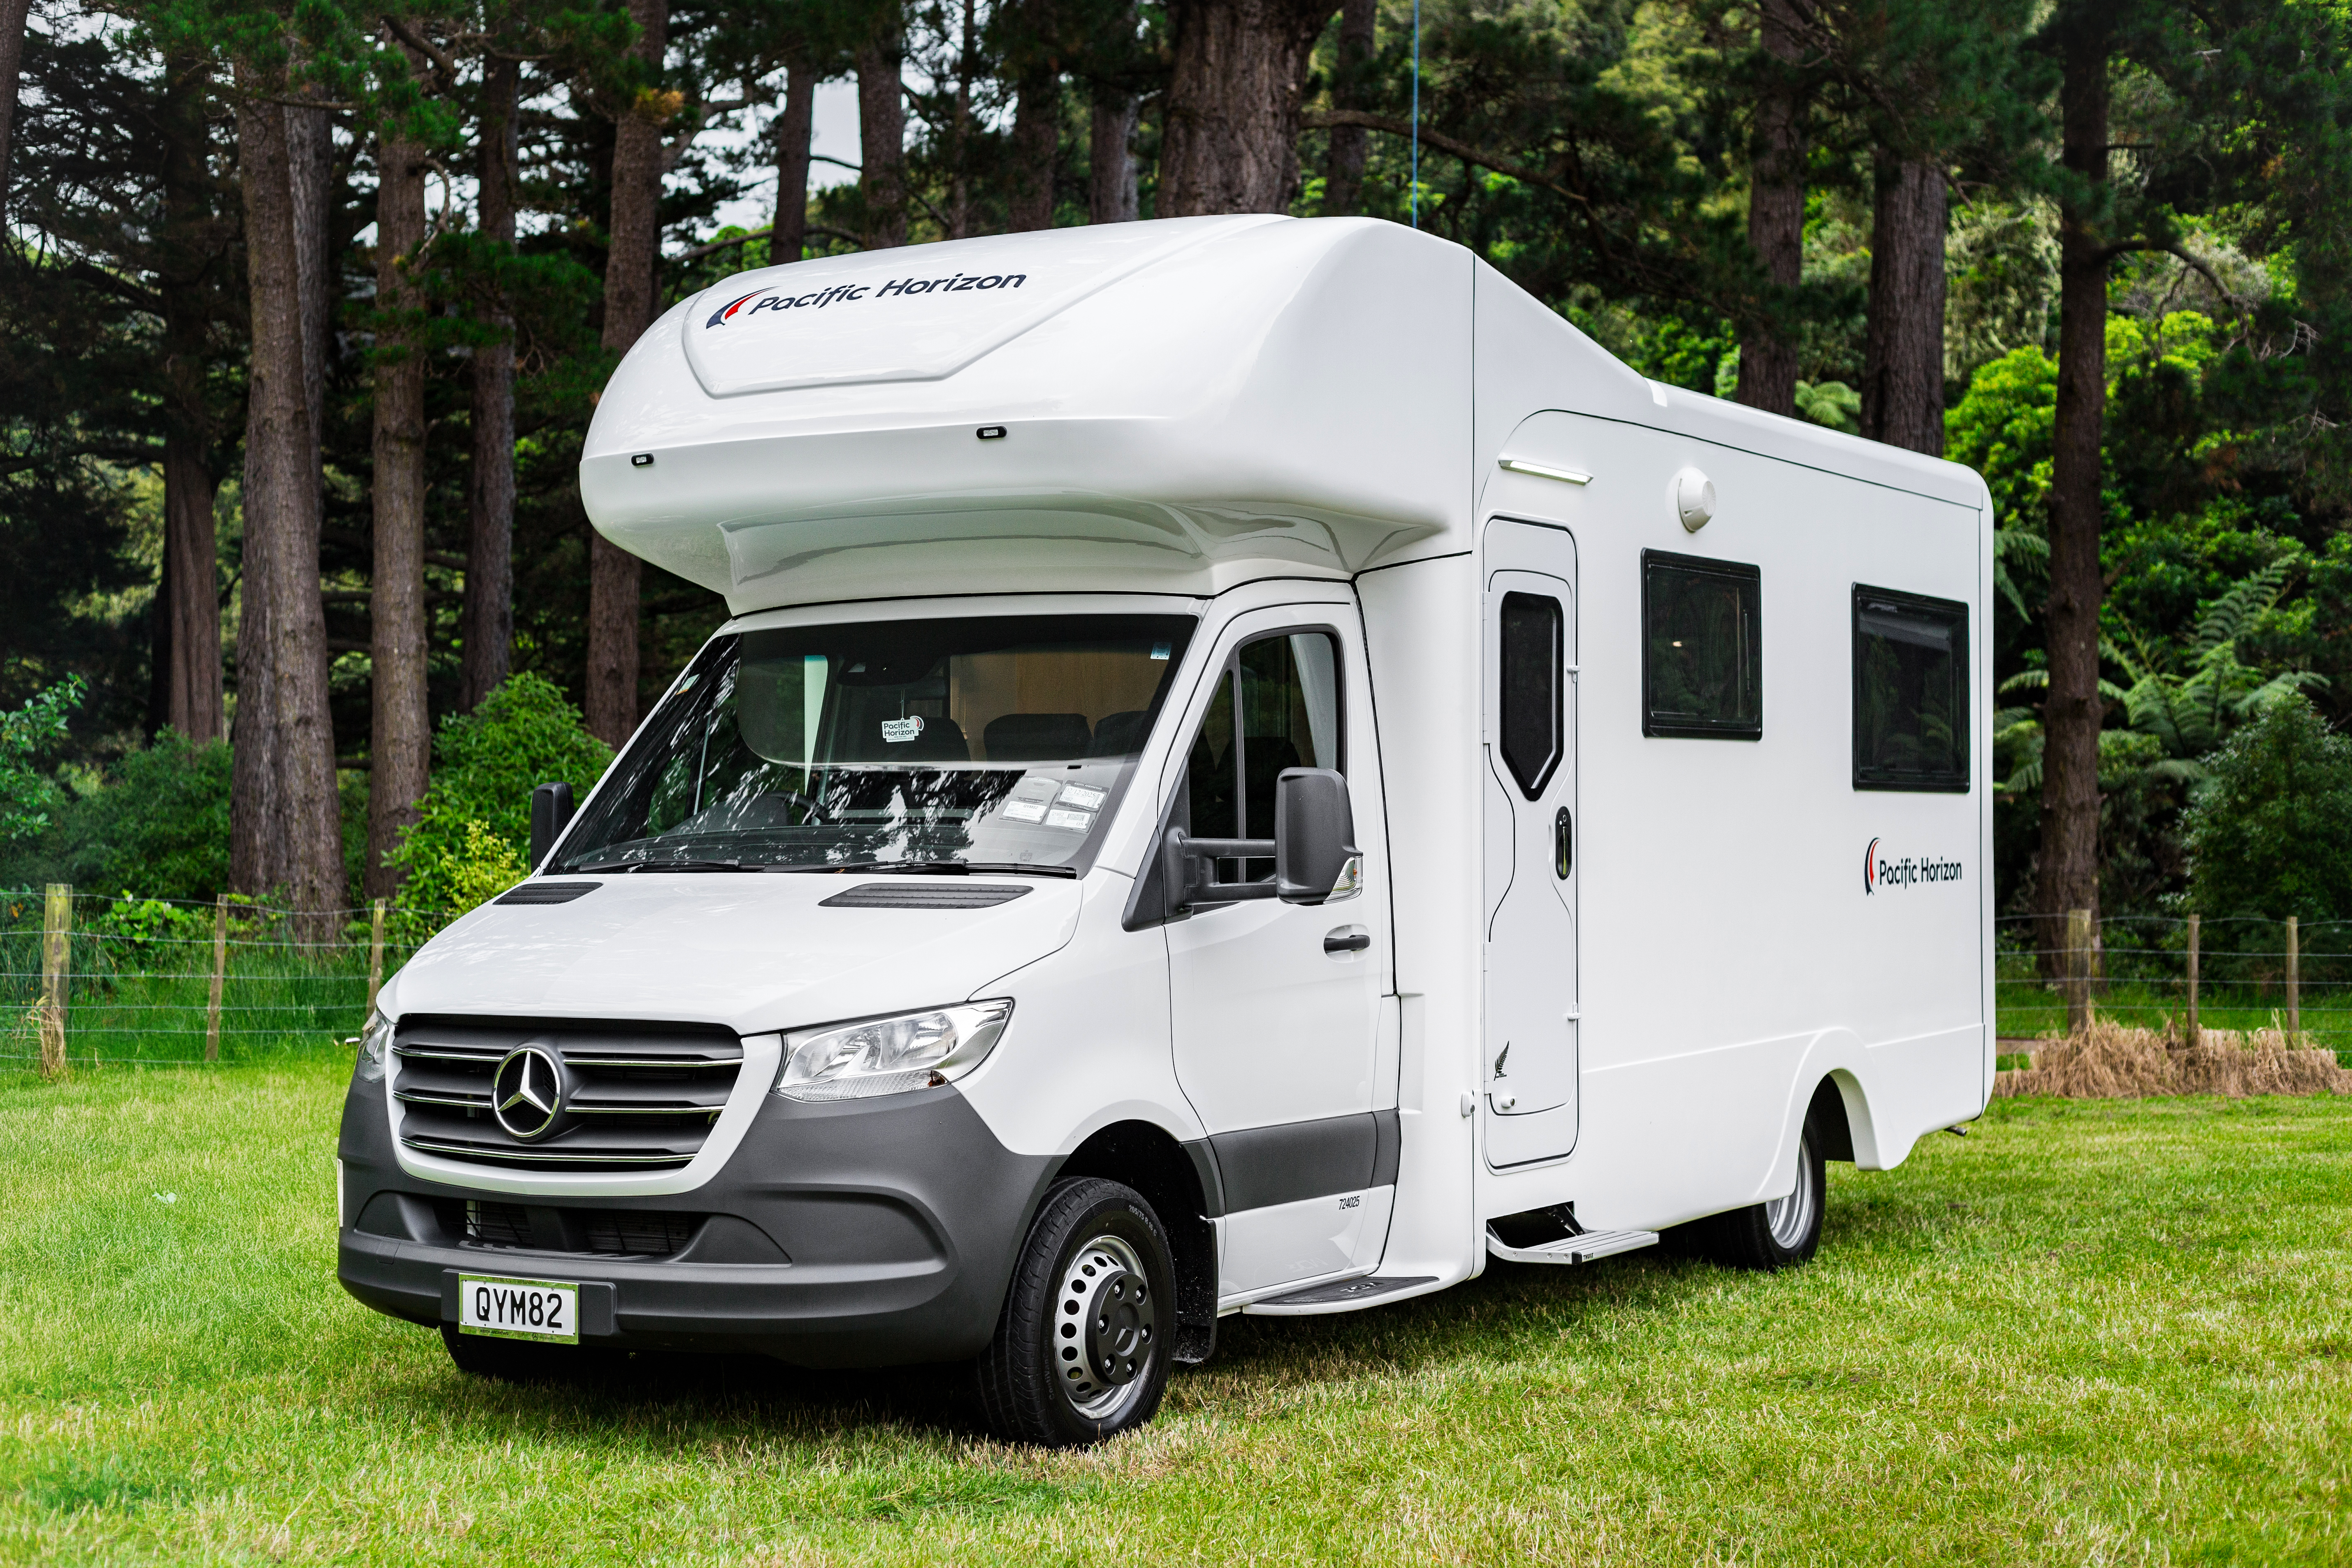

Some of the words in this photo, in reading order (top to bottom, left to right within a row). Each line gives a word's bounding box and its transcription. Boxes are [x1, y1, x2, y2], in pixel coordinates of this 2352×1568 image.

[747, 284, 871, 315] Pacific
[875, 273, 1027, 298] Horizon
[884, 721, 910, 730] Pacific
[1065, 787, 1096, 798] 02/12/2025
[1879, 858, 1917, 890] Pacific
[1921, 856, 1962, 882] Horizon
[1339, 1195, 1360, 1210] 724025
[1129, 1205, 1144, 1220] 205/75
[1149, 1222, 1153, 1231] 16
[476, 1287, 562, 1328] QYM82
